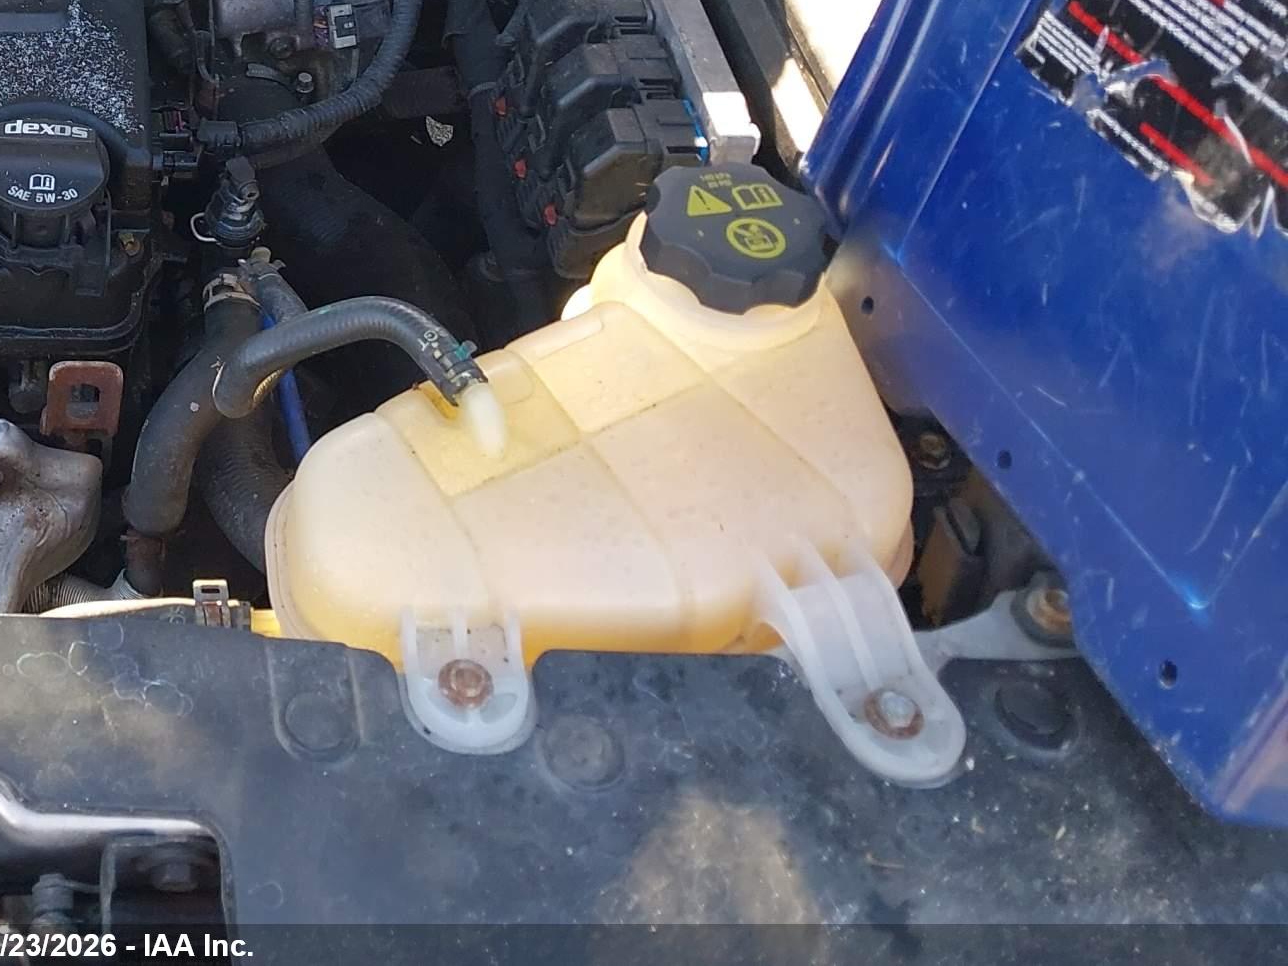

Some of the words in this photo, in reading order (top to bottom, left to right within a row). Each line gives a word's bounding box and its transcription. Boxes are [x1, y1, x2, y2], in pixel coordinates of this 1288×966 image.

[4, 119, 89, 139] dexos
[7, 185, 32, 202] SAE
[35, 187, 79, 203] 5W-30
